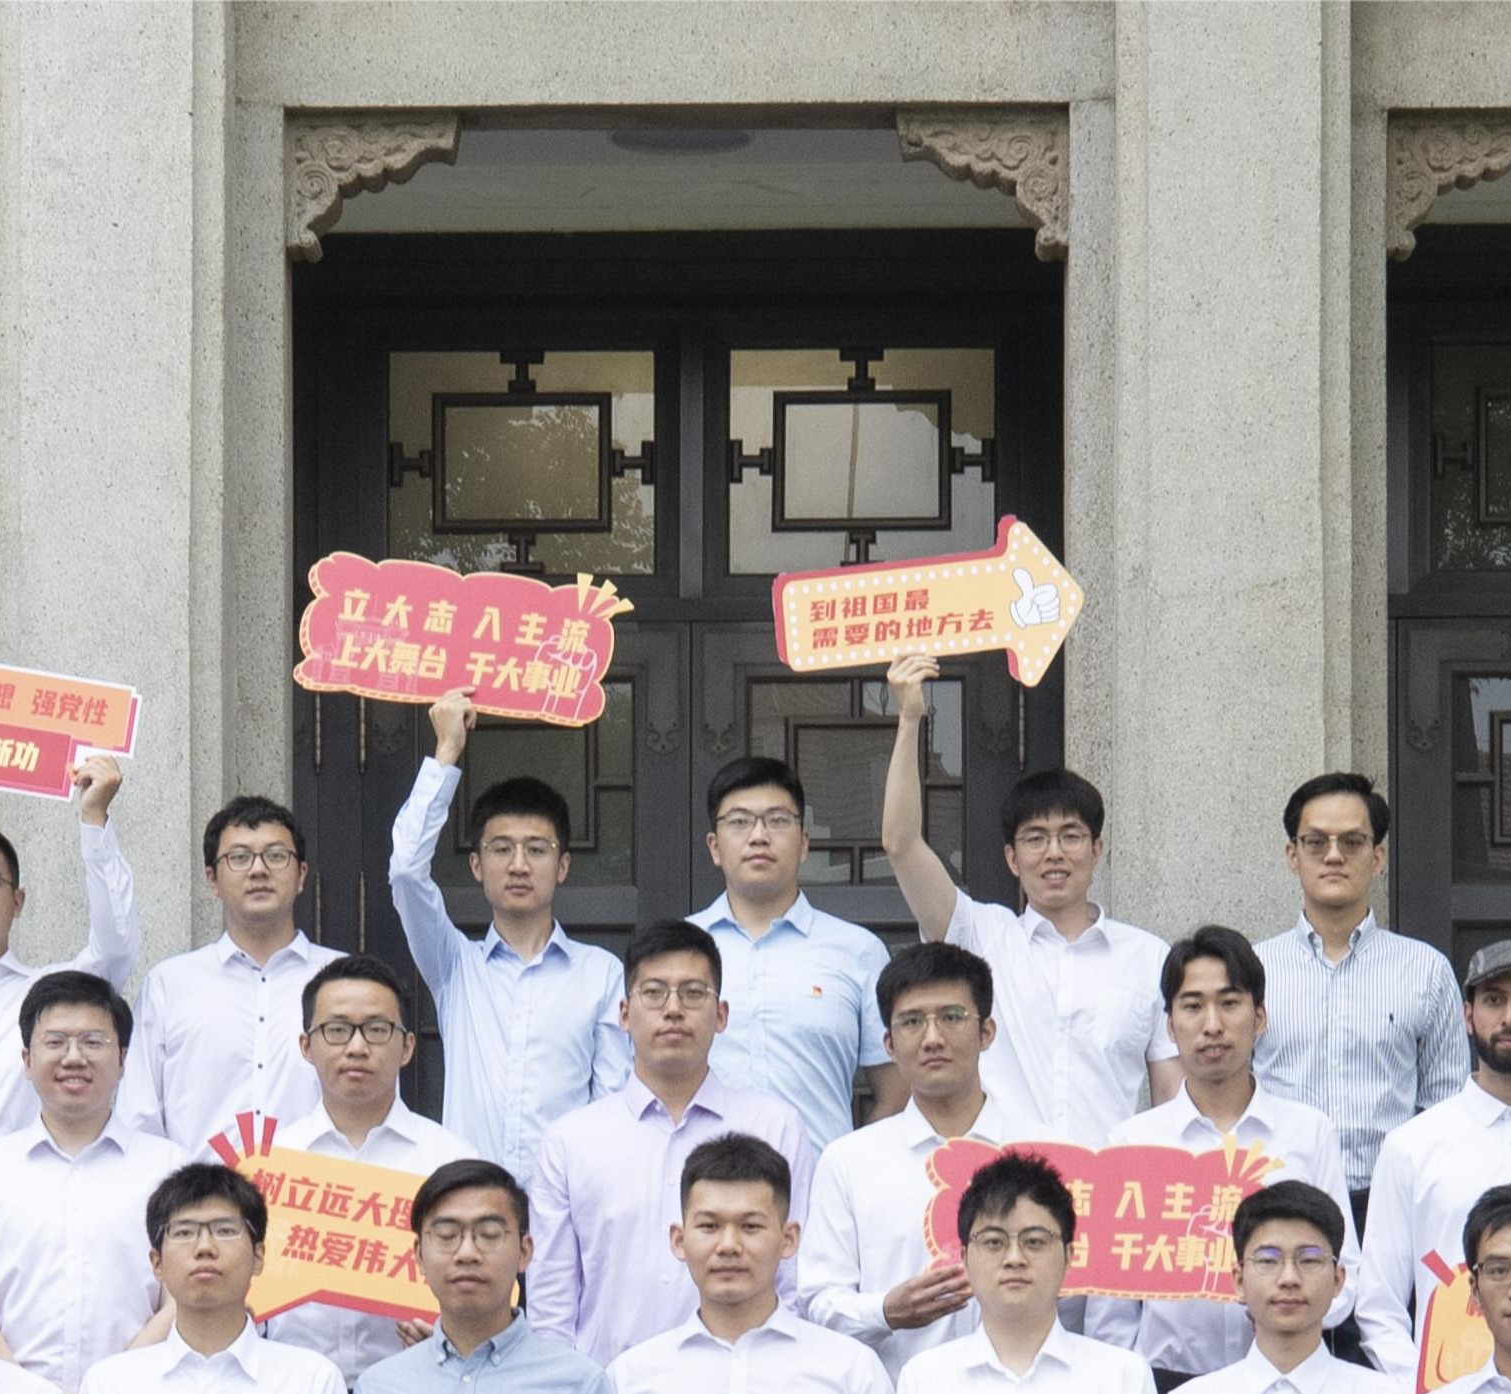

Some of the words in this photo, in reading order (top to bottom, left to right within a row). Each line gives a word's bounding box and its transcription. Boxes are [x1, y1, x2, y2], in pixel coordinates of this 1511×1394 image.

[809, 588, 930, 623] 到祖国最
[812, 608, 995, 650] 需要的地方去
[331, 634, 447, 680] 上大舞台
[30, 688, 109, 726] 强党性
[281, 1223, 430, 1286] 热爱伟大
